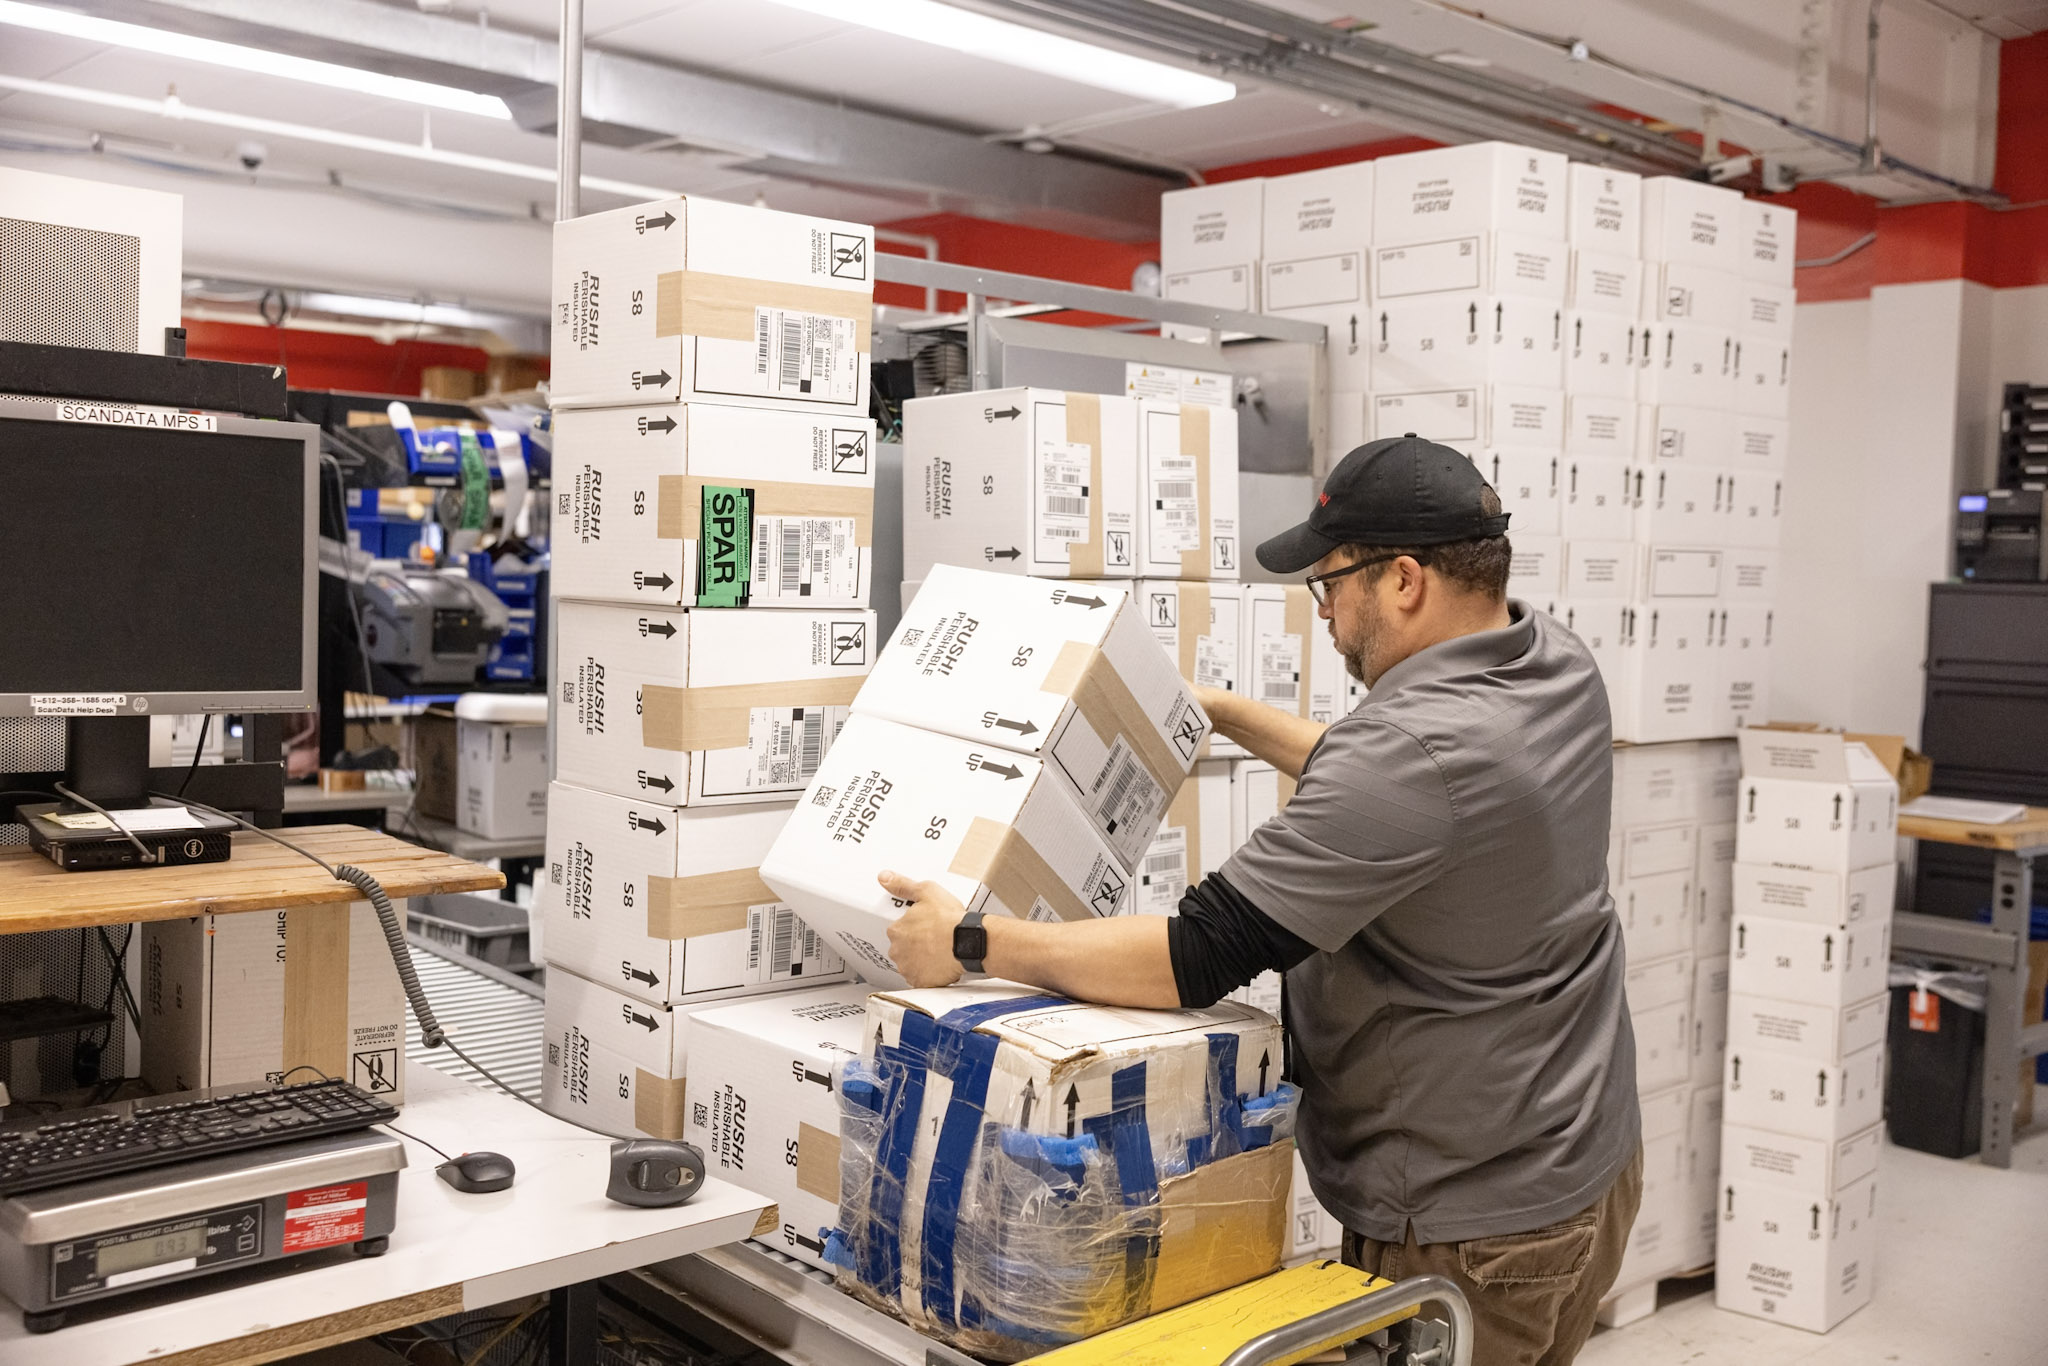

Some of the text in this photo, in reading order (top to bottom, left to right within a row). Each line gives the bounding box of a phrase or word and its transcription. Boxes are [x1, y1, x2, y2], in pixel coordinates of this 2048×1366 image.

[1413, 199, 1451, 214] RUSH!
[635, 215, 645, 235] UP
[580, 270, 589, 351] PERISHABLE
[588, 275, 600, 346] RUSH!
[631, 290, 643, 316] S8
[825, 347, 831, 356] VT
[1420, 338, 1434, 351] S8
[631, 371, 641, 391] UP
[62, 405, 212, 430] SCANDATA MPS 1
[638, 416, 647, 436] UP
[984, 407, 993, 424] UP
[813, 426, 818, 435] DO
[924, 465, 932, 513] INSULATED
[932, 456, 941, 521] PERISHABLE
[940, 460, 952, 517] RUSH!
[982, 475, 993, 495] S8
[582, 464, 591, 544] PERISHABLE
[590, 469, 602, 540] RUSH!
[634, 490, 645, 516] S8
[712, 493, 735, 585] SPAR
[707, 555, 712, 563] AT
[824, 549, 829, 559] MA
[984, 546, 994, 562] UP
[633, 571, 643, 590] UP
[1049, 589, 1067, 605] UP
[638, 618, 648, 638] UP
[812, 621, 817, 630] DO
[914, 617, 948, 666] INSULATED
[921, 611, 967, 677] PERISHABLE
[937, 617, 980, 676] RUSH!
[1011, 645, 1034, 668] S8
[135, 697, 146, 712] hp
[586, 656, 594, 736] PERISHABLE
[595, 663, 605, 733] RUSH!
[980, 711, 998, 729] UP
[772, 745, 778, 756] MA
[965, 752, 984, 772] UP
[637, 769, 646, 790] UP
[1126, 779, 1140, 803] GROUND
[826, 776, 861, 829] INSULATED
[832, 770, 880, 843] PERISHABLE
[848, 778, 894, 845] RUSH!
[628, 811, 637, 831] UP
[923, 815, 948, 841] S8
[565, 848, 573, 907] INSULATED
[573, 841, 583, 920] PERISHABLE
[581, 848, 593, 920] RUSH!
[623, 882, 634, 908] S8
[276, 911, 286, 940] SHIP
[622, 960, 631, 981] UP
[622, 1003, 632, 1025] UP
[353, 1026, 375, 1035] FREEZE
[356, 1031, 395, 1041] REFRIGERATE
[562, 1031, 570, 1090] INSULATED
[570, 1025, 579, 1103] PERISHABLE
[578, 1034, 590, 1105] RUSH!
[792, 1060, 804, 1083] UP
[618, 1073, 629, 1099] S8
[711, 1090, 721, 1153] INSULATED
[721, 1084, 733, 1169] PERISHABLE
[731, 1093, 747, 1171] RUSH!
[785, 1138, 798, 1167] S8
[98, 1218, 209, 1248] POSTAL WEIGHT CLASSIFIER
[208, 1223, 231, 1236] lb/oz
[783, 1223, 795, 1246] UP
[207, 1246, 217, 1255] lb
[1750, 1262, 1792, 1280] RUSH!
